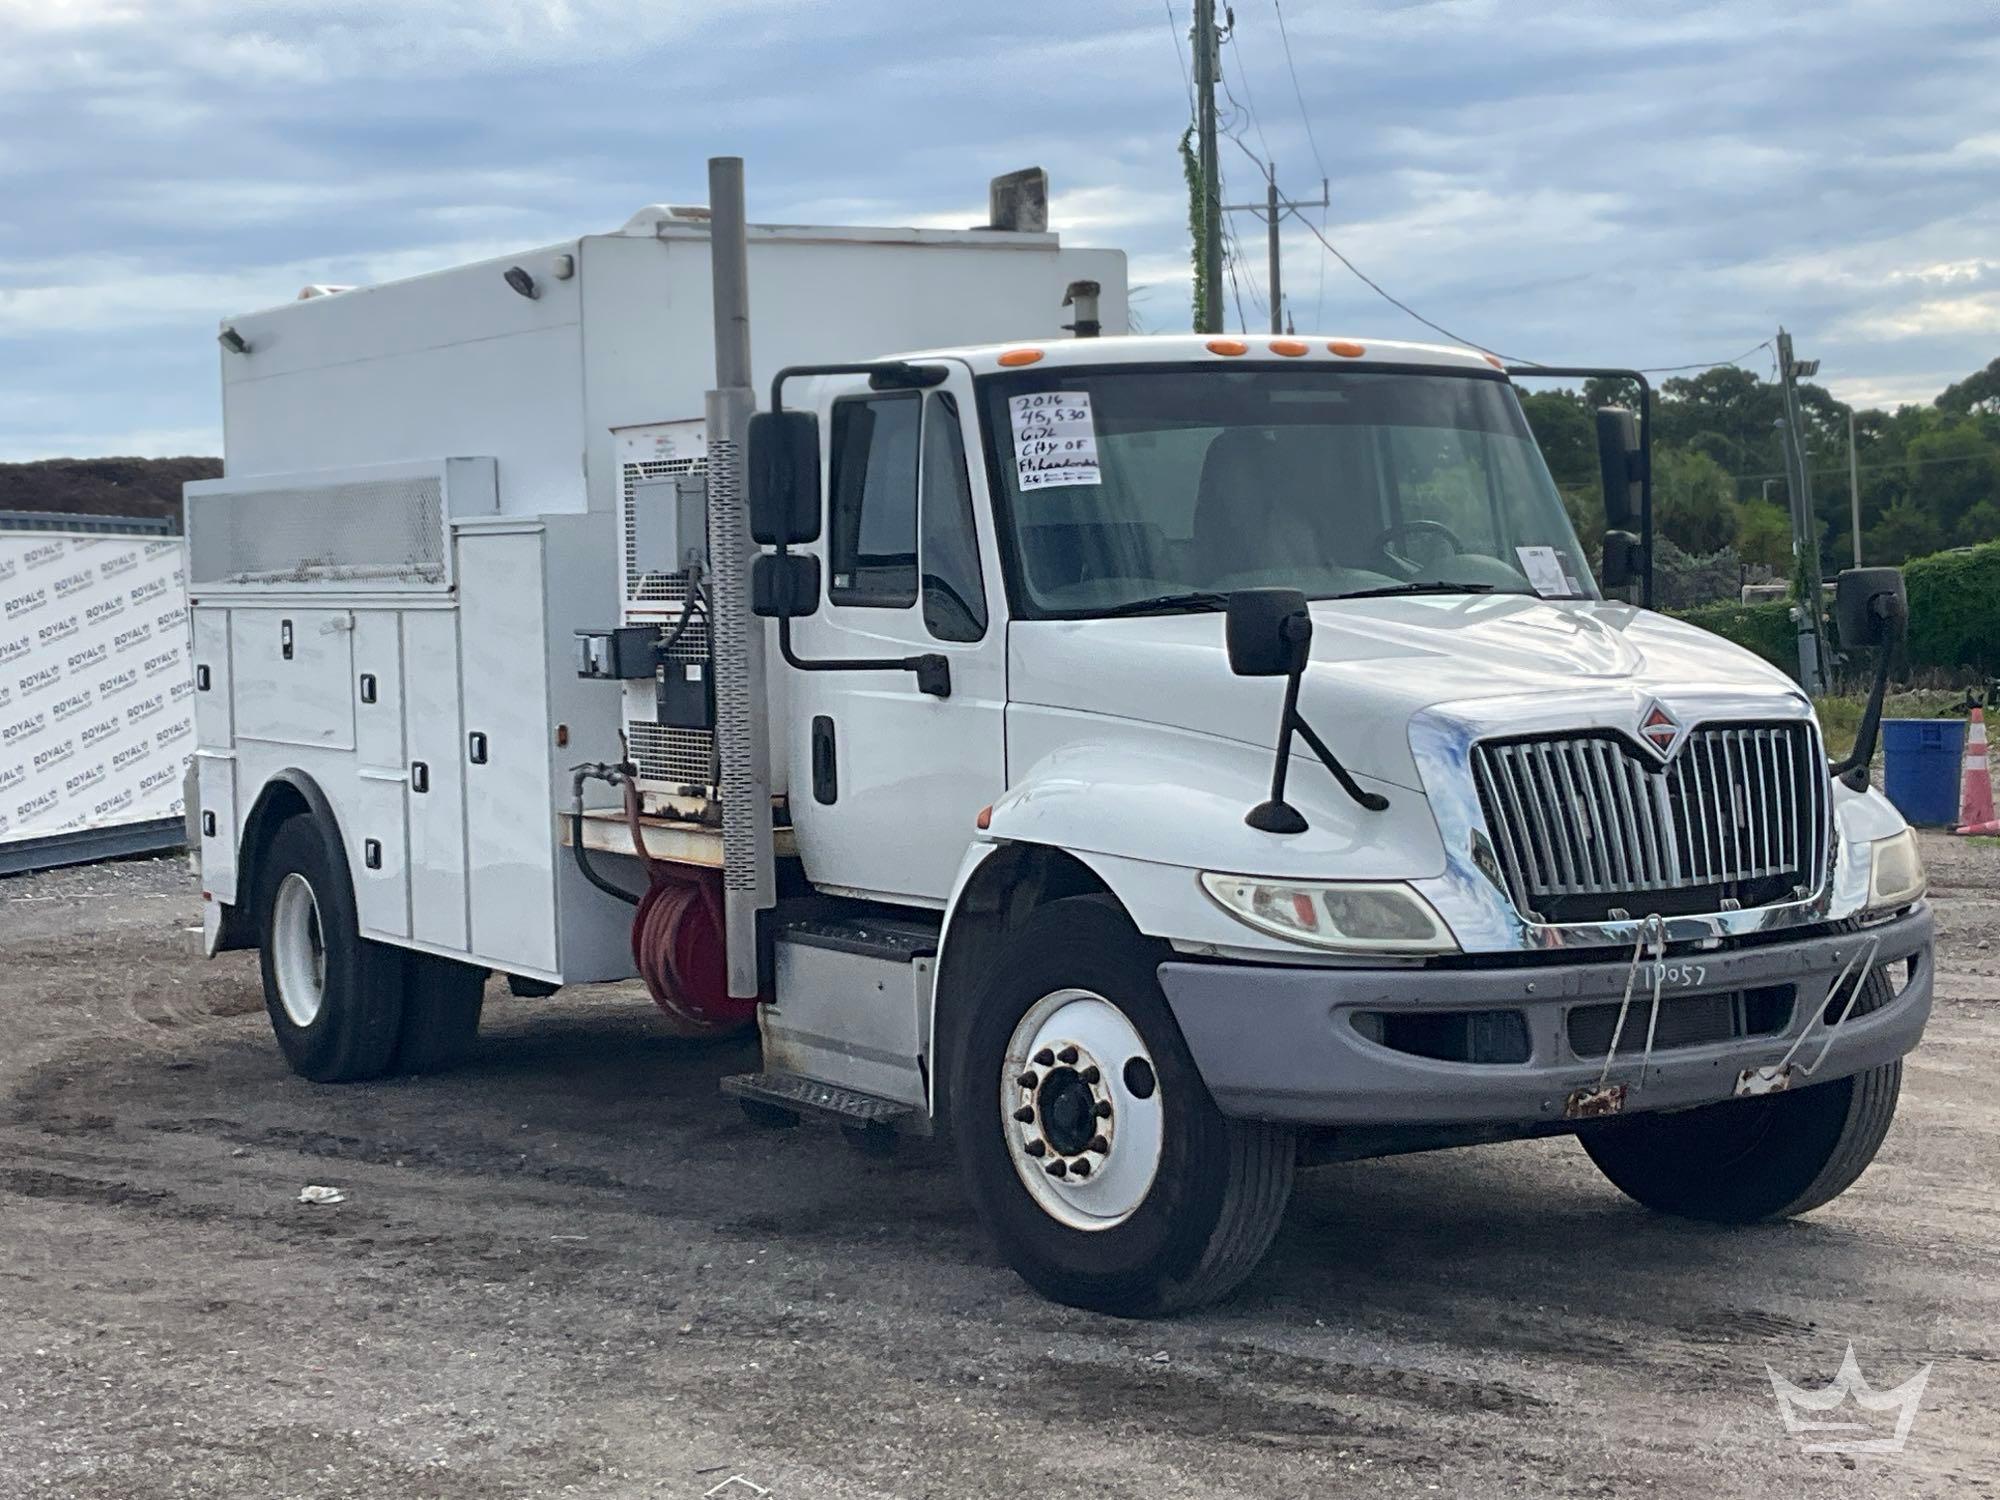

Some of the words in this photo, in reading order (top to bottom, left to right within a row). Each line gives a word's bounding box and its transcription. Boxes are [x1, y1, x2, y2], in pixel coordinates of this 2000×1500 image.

[1017, 395, 1063, 410] 2016
[1021, 409, 1085, 425] 45,530
[24, 546, 55, 562] ROYAL
[101, 557, 130, 572] ROYAL
[54, 574, 84, 592] ROYAL
[131, 582, 159, 599] ROYAL
[5, 593, 37, 612] ROYAL
[86, 600, 116, 618] ROYAL
[158, 608, 185, 625] ROYAL
[39, 620, 69, 639] ROYAL
[115, 628, 142, 646] ROYAL
[68, 647, 98, 666] ROYAL
[145, 653, 172, 671] ROYAL
[20, 670, 52, 689] ROYAL
[101, 674, 128, 690] ROYAL
[53, 696, 82, 715] ROYAL
[127, 700, 155, 718] ROYAL
[3, 719, 36, 739] ROYAL
[82, 722, 111, 741] ROYAL
[157, 724, 183, 741] ROYAL
[34, 746, 64, 766] ROYAL
[113, 747, 139, 765] ROYAL
[66, 771, 96, 790] ROYAL
[140, 772, 168, 789] ROYAL
[18, 796, 48, 816] ROYAL
[95, 796, 126, 814] ROYAL
